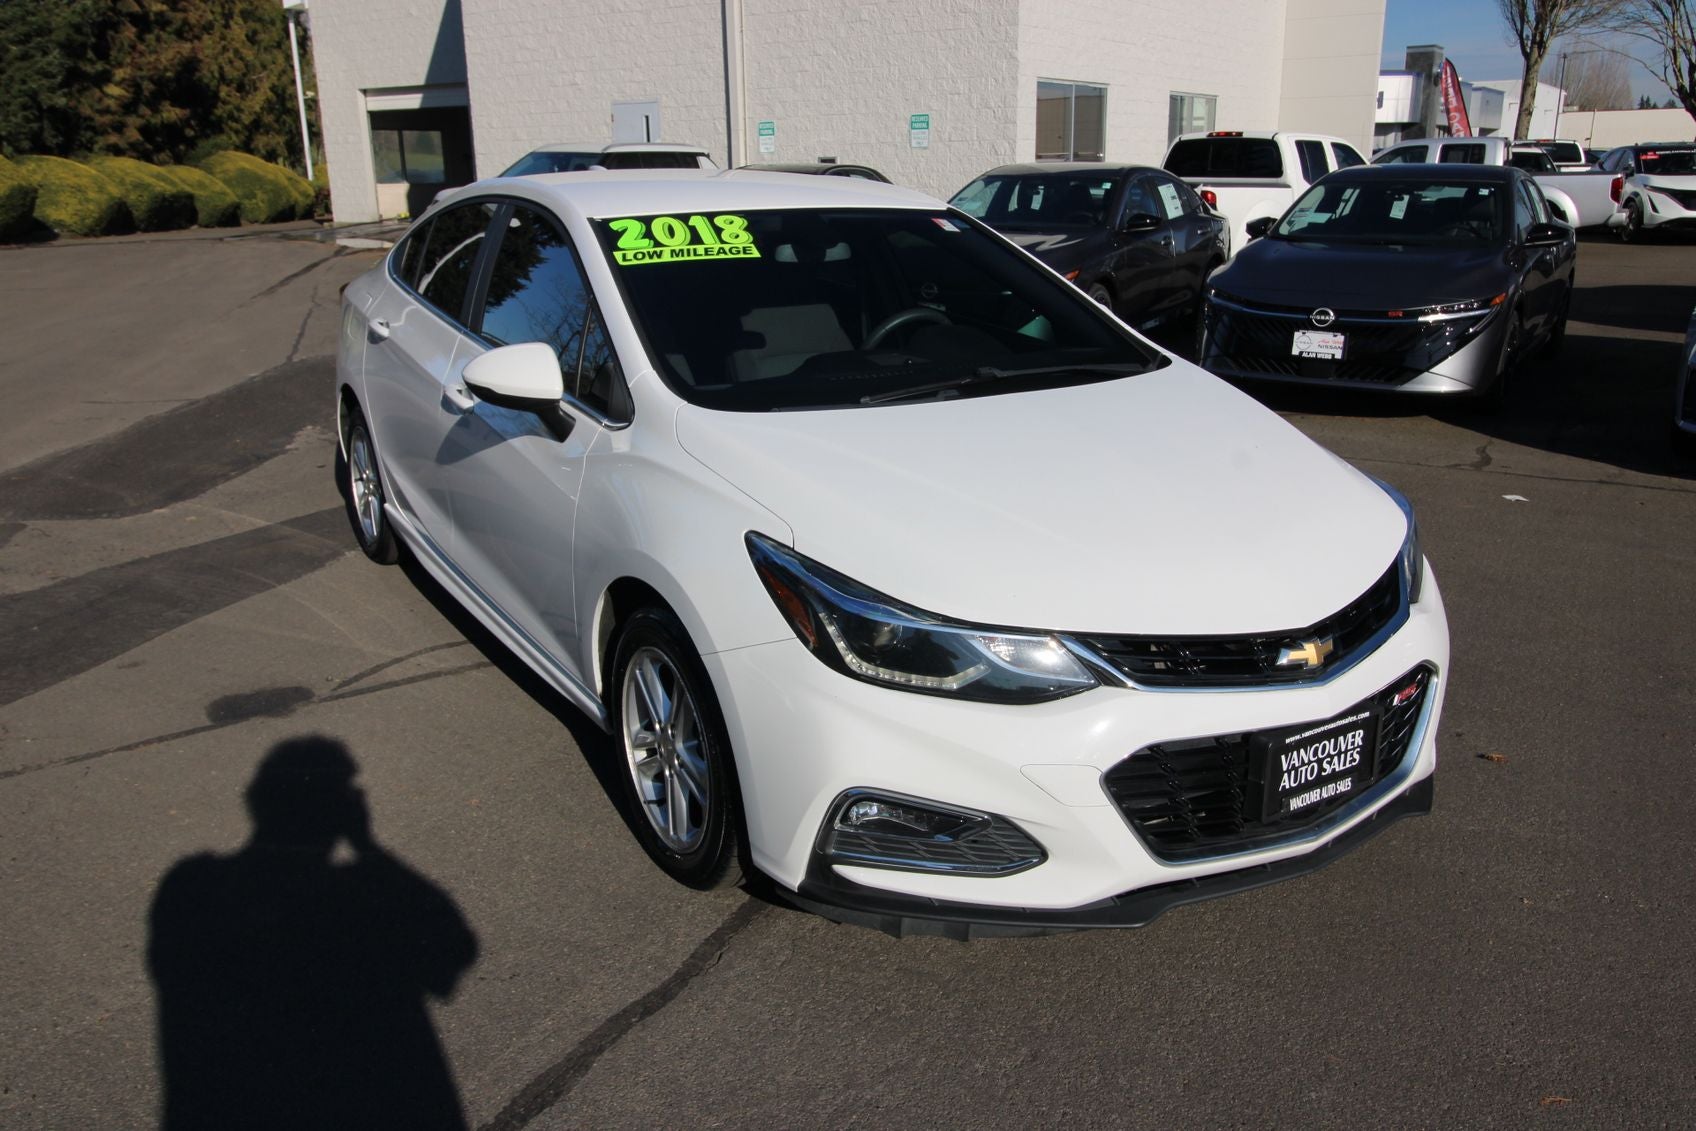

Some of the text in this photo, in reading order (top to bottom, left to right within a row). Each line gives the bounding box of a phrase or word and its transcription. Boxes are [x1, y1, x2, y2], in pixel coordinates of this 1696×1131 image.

[609, 215, 753, 249] 2018
[622, 246, 753, 262] LOW MILEAGE
[1281, 729, 1364, 771] VANCOUVER
[1279, 748, 1361, 791] AUTO SALES
[1290, 777, 1352, 811] VANCOUVER AUTO SALES
